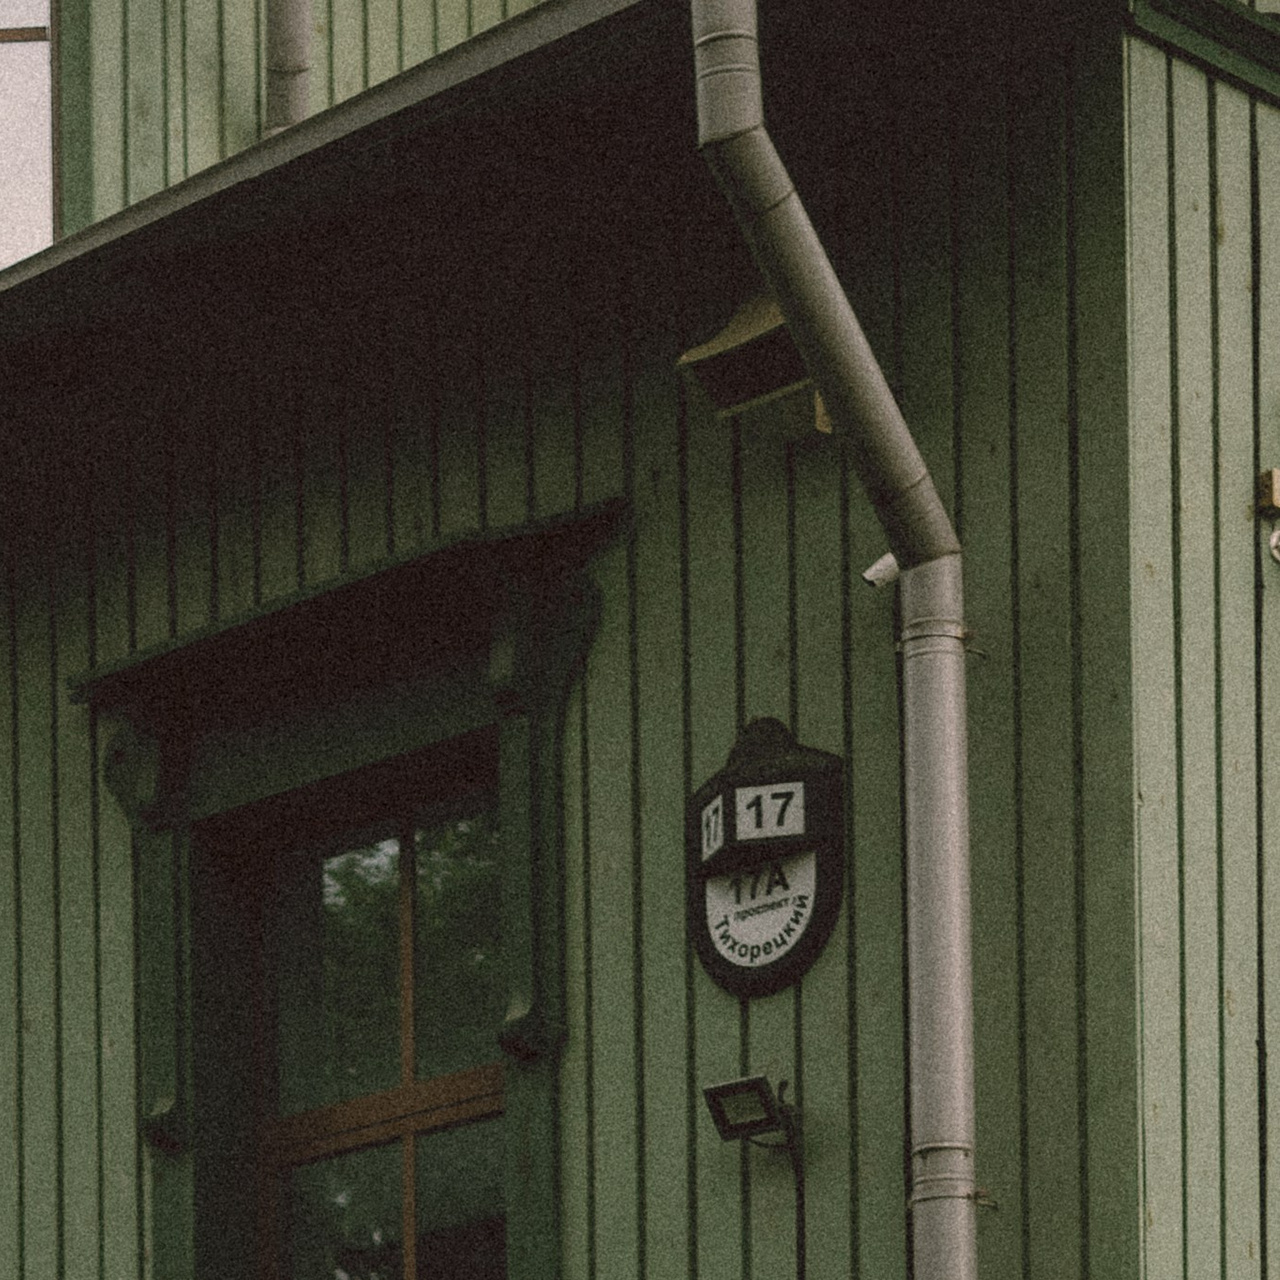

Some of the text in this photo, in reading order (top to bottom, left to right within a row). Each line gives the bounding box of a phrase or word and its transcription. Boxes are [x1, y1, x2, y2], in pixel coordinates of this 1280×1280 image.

[704, 804, 720, 850] 17
[745, 790, 795, 829] 17
[715, 894, 809, 964] Тихорецкий
[733, 897, 791, 921] проспект
